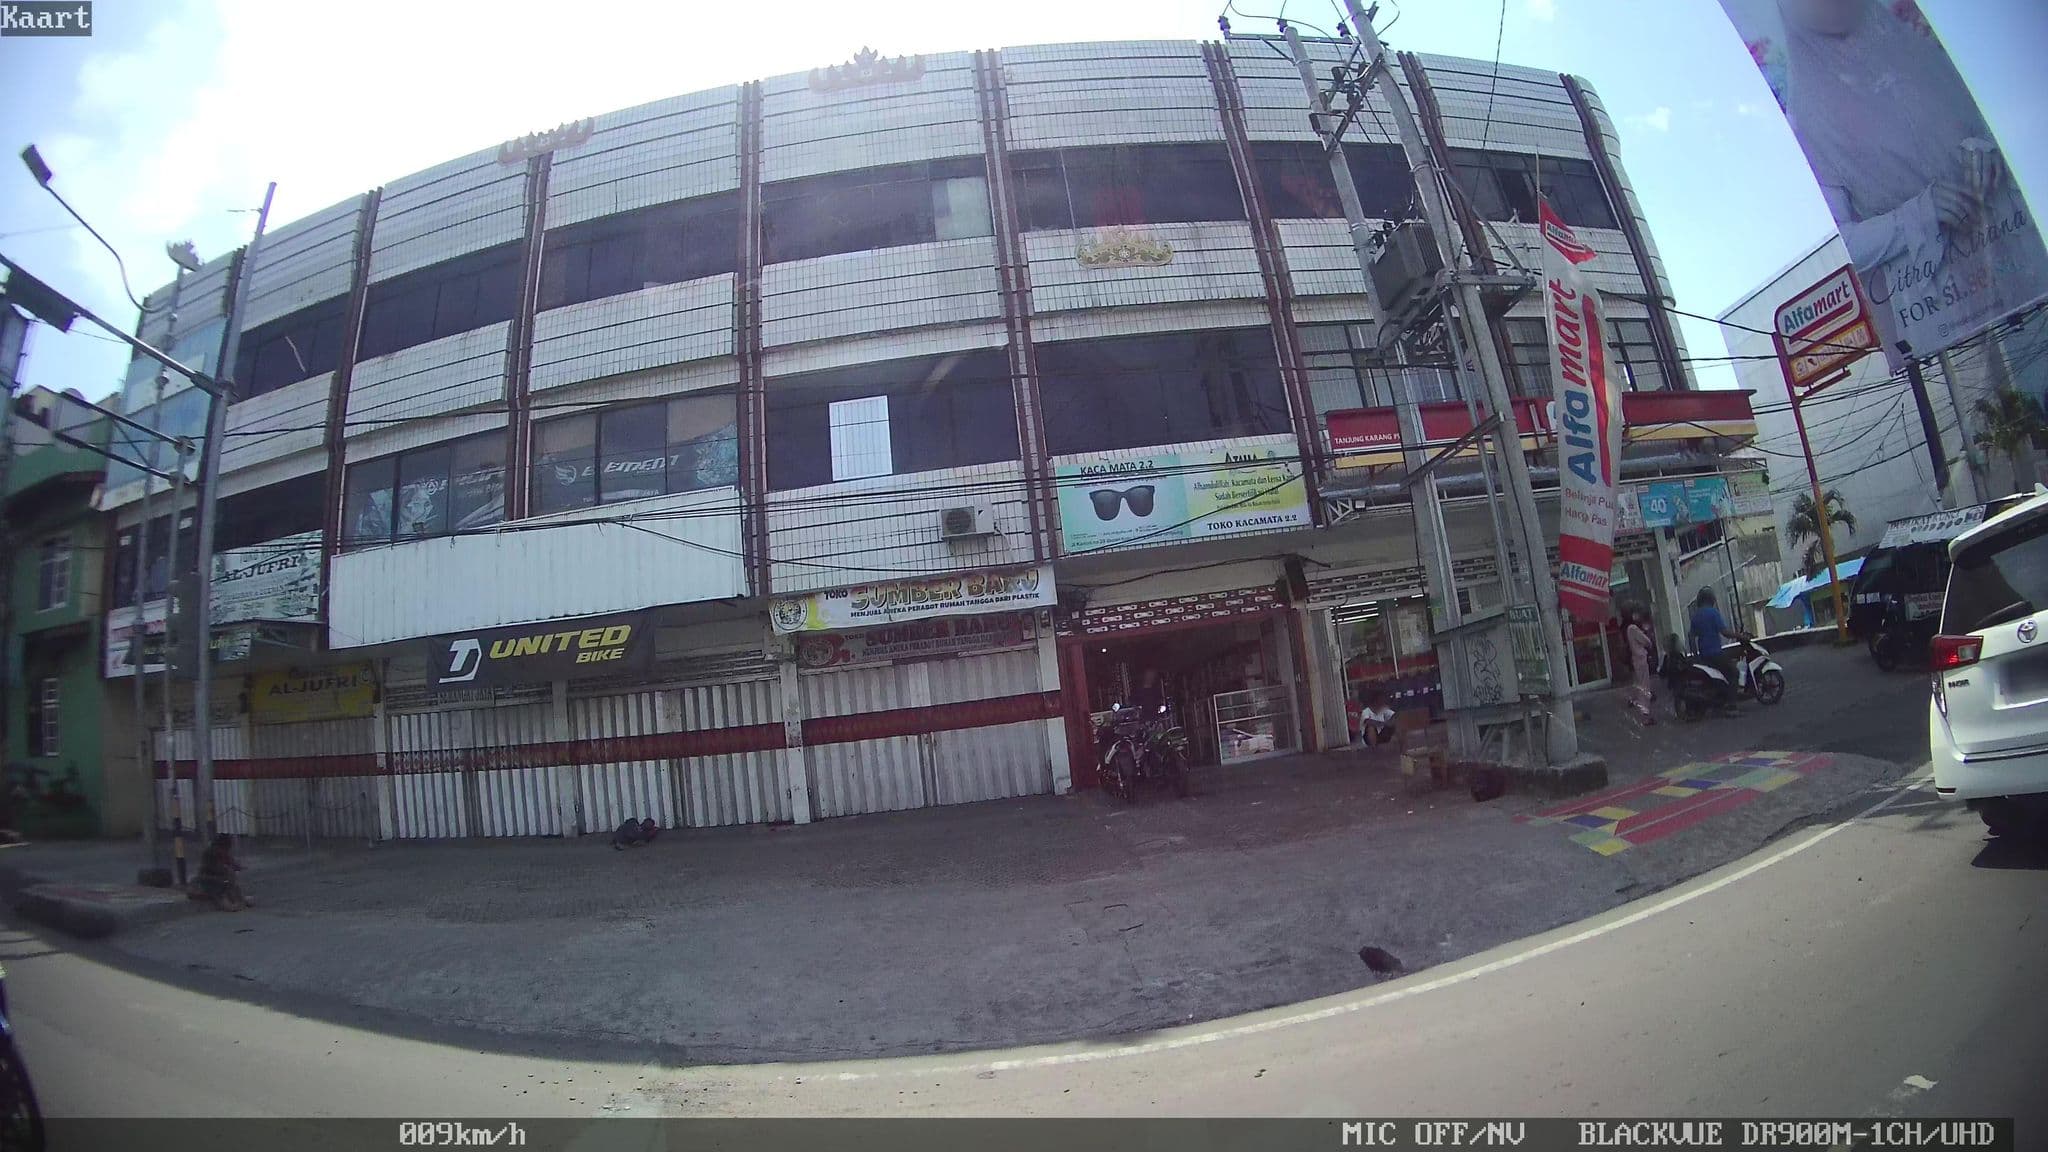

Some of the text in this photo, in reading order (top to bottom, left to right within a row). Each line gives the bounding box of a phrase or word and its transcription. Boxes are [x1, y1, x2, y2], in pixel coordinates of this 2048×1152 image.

[1868, 258, 1937, 305] Citra
[1782, 280, 1851, 334] Alfamart
[1899, 296, 1940, 328] FOR
[1548, 278, 1597, 485] Alfamart
[1334, 435, 1364, 445] TANJUNG
[1364, 433, 1393, 443] KARANG
[1080, 466, 1106, 476] KACA
[1109, 461, 1137, 472] MATA
[1207, 521, 1233, 531] TOKO
[1235, 516, 1283, 528] KACAMATA
[1561, 562, 1609, 588] Alfamar
[823, 569, 1039, 611] TOKO SUMBER BARU
[850, 609, 882, 617] MENJUAL
[908, 603, 938, 612] PERABOT
[939, 601, 965, 609] RUMAH
[966, 598, 994, 606] TANGGA
[1011, 592, 1040, 601] PLASTIK
[489, 624, 632, 659] UNITED
[575, 648, 625, 664] BIKE
[268, 675, 357, 696] AL-JUFRI
